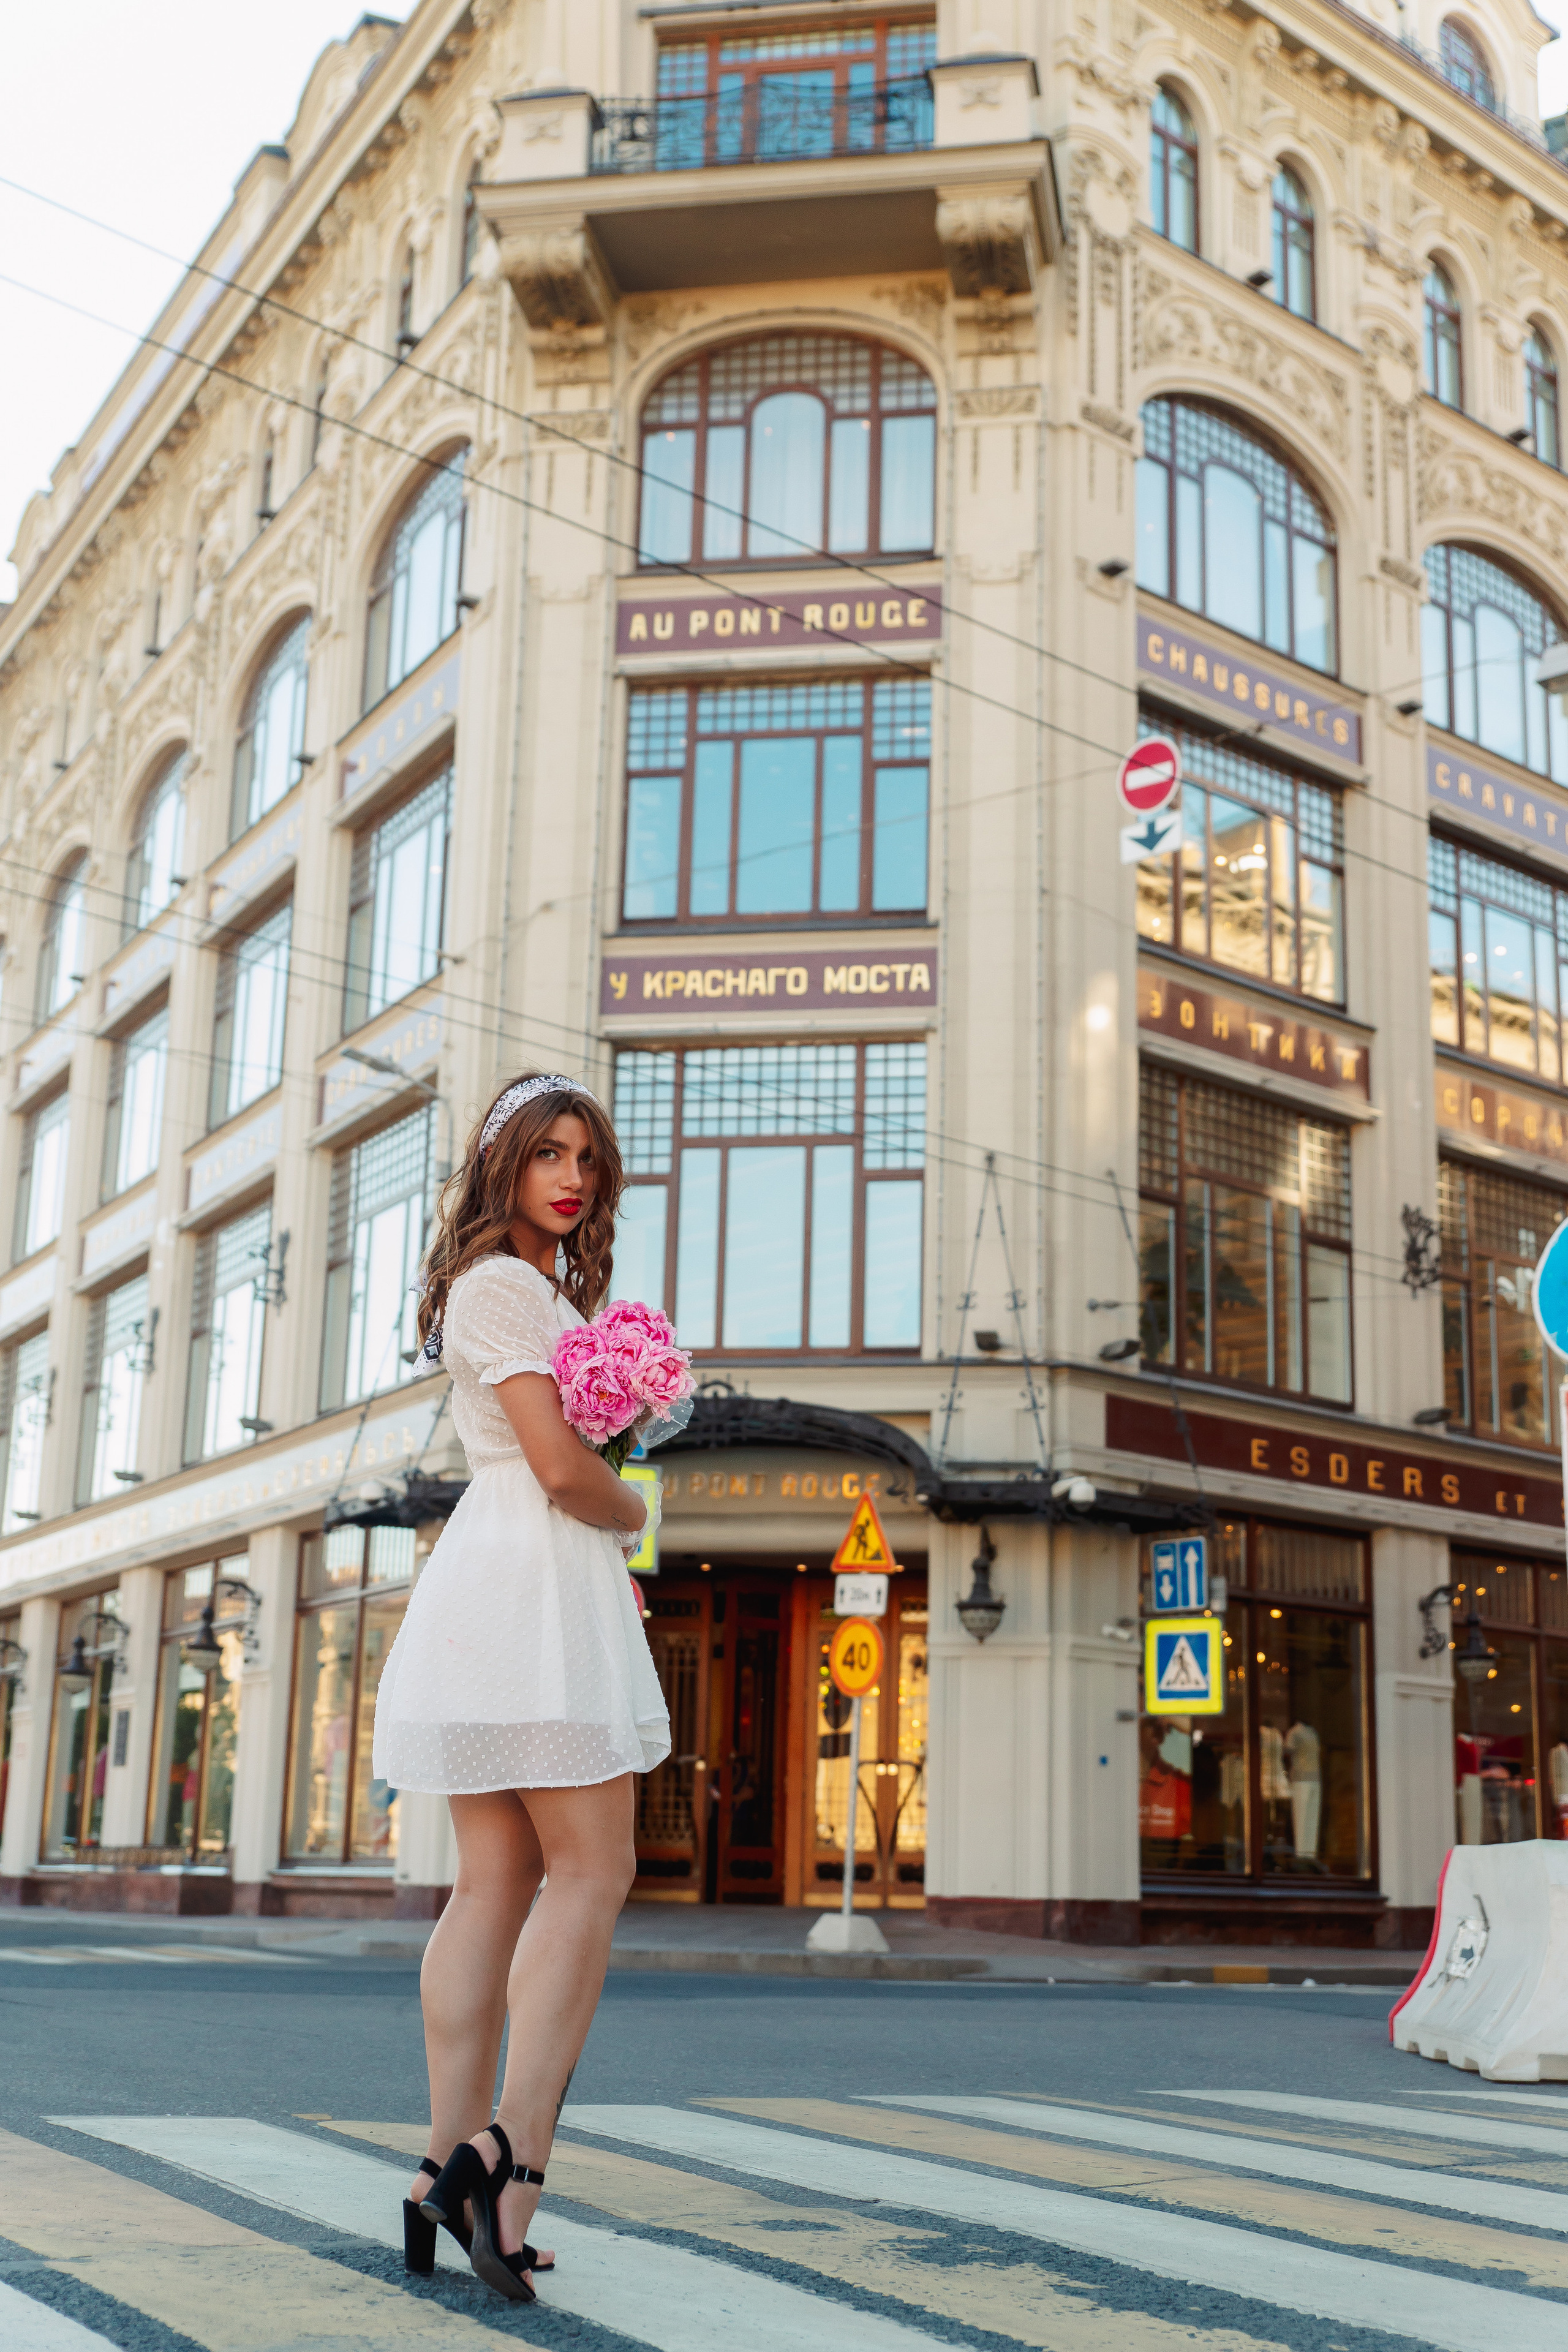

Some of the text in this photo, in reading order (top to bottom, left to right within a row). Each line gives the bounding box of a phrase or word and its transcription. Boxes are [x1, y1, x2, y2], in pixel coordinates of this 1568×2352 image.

[629, 598, 929, 642] AU PONT ROUGE
[1147, 633, 1349, 745] CHAUSSURES
[1435, 761, 1568, 846] CRAVAT
[609, 963, 931, 1001] У КРАСНАГО МОСТА
[1150, 989, 1357, 1081] ЗОНТИКИ
[689, 1472, 764, 1498] PONT
[780, 1472, 881, 1499] ROUGE
[1250, 1438, 1461, 1505] ESDERS
[1495, 1490, 1526, 1516] ET
[842, 1642, 871, 1672] 40
